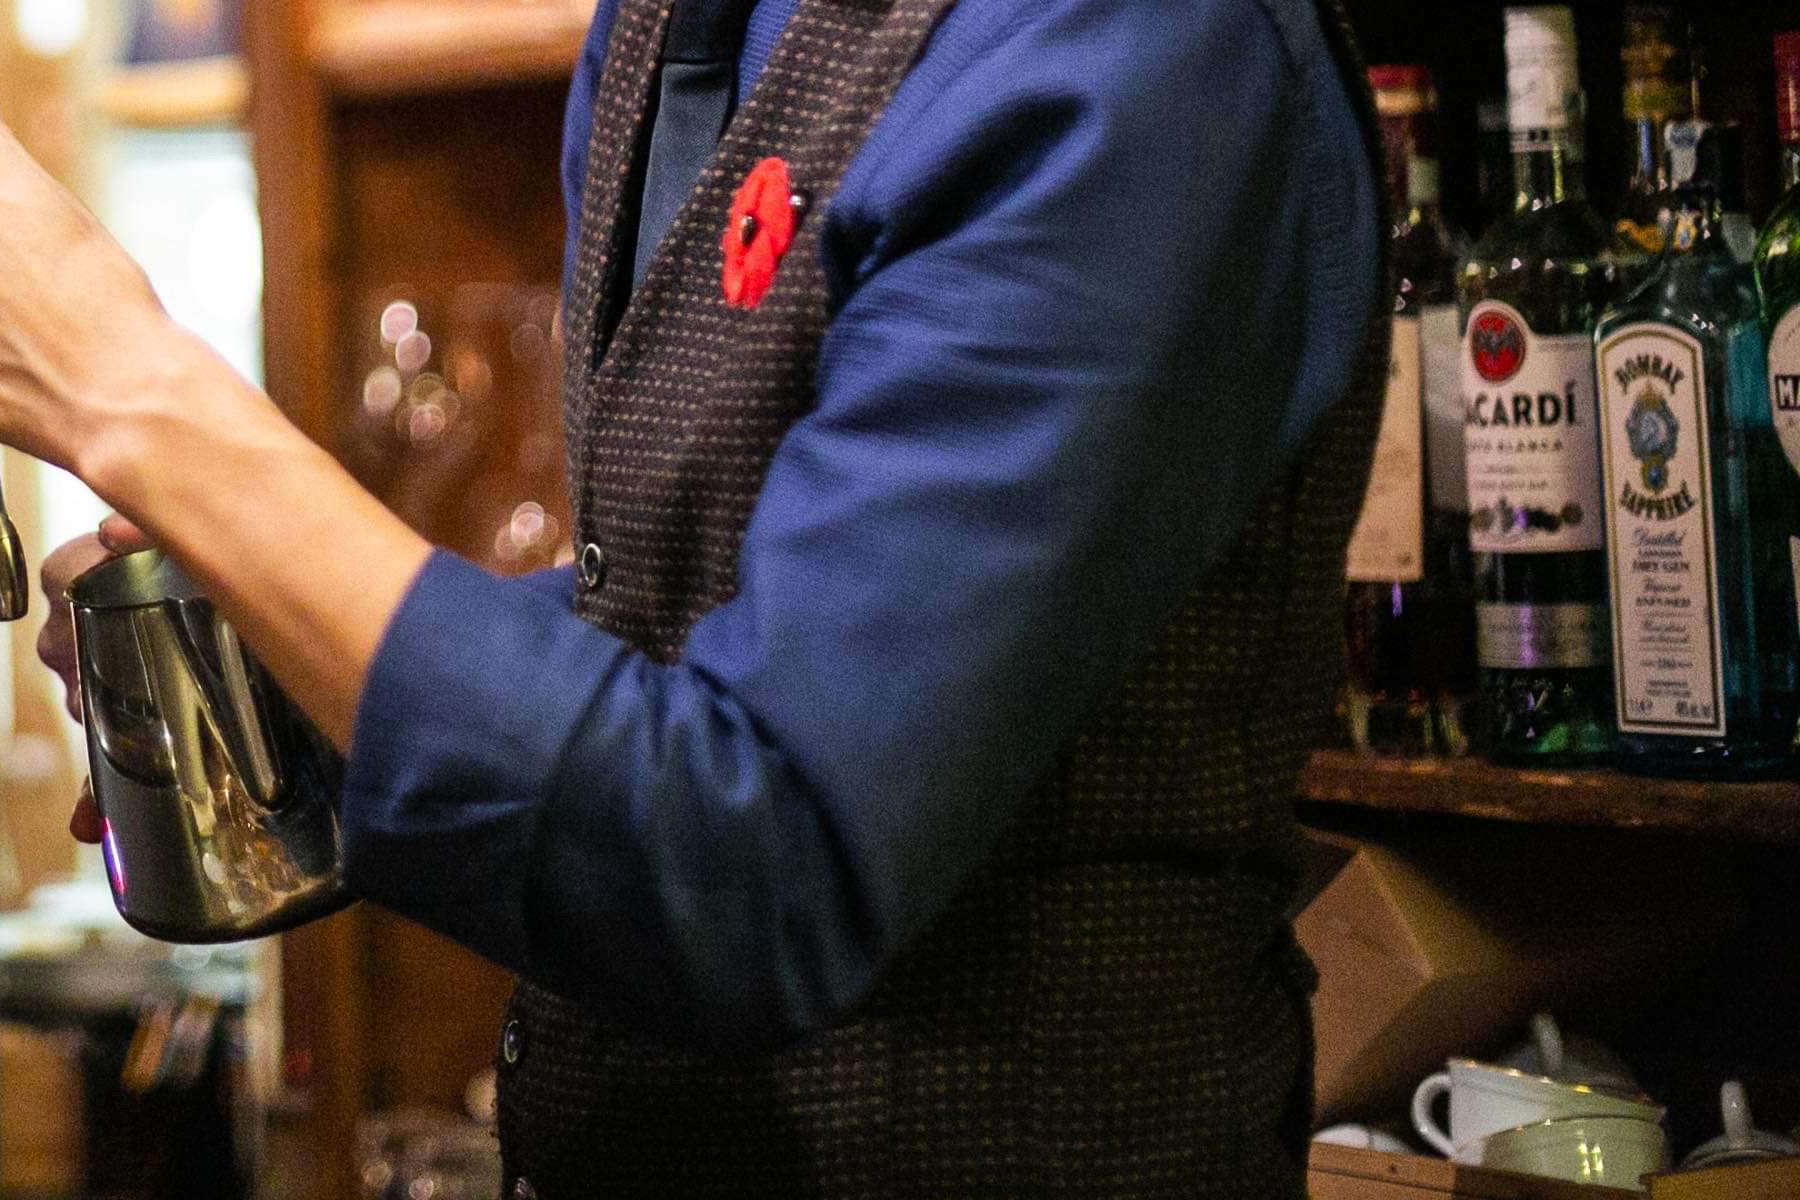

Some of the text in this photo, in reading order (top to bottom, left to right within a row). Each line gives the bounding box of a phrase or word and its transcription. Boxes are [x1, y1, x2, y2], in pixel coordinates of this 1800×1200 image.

[1615, 353, 1685, 396] BOMBAY
[1777, 377, 1800, 407] M
[1619, 480, 1695, 521] SAPPHIRE
